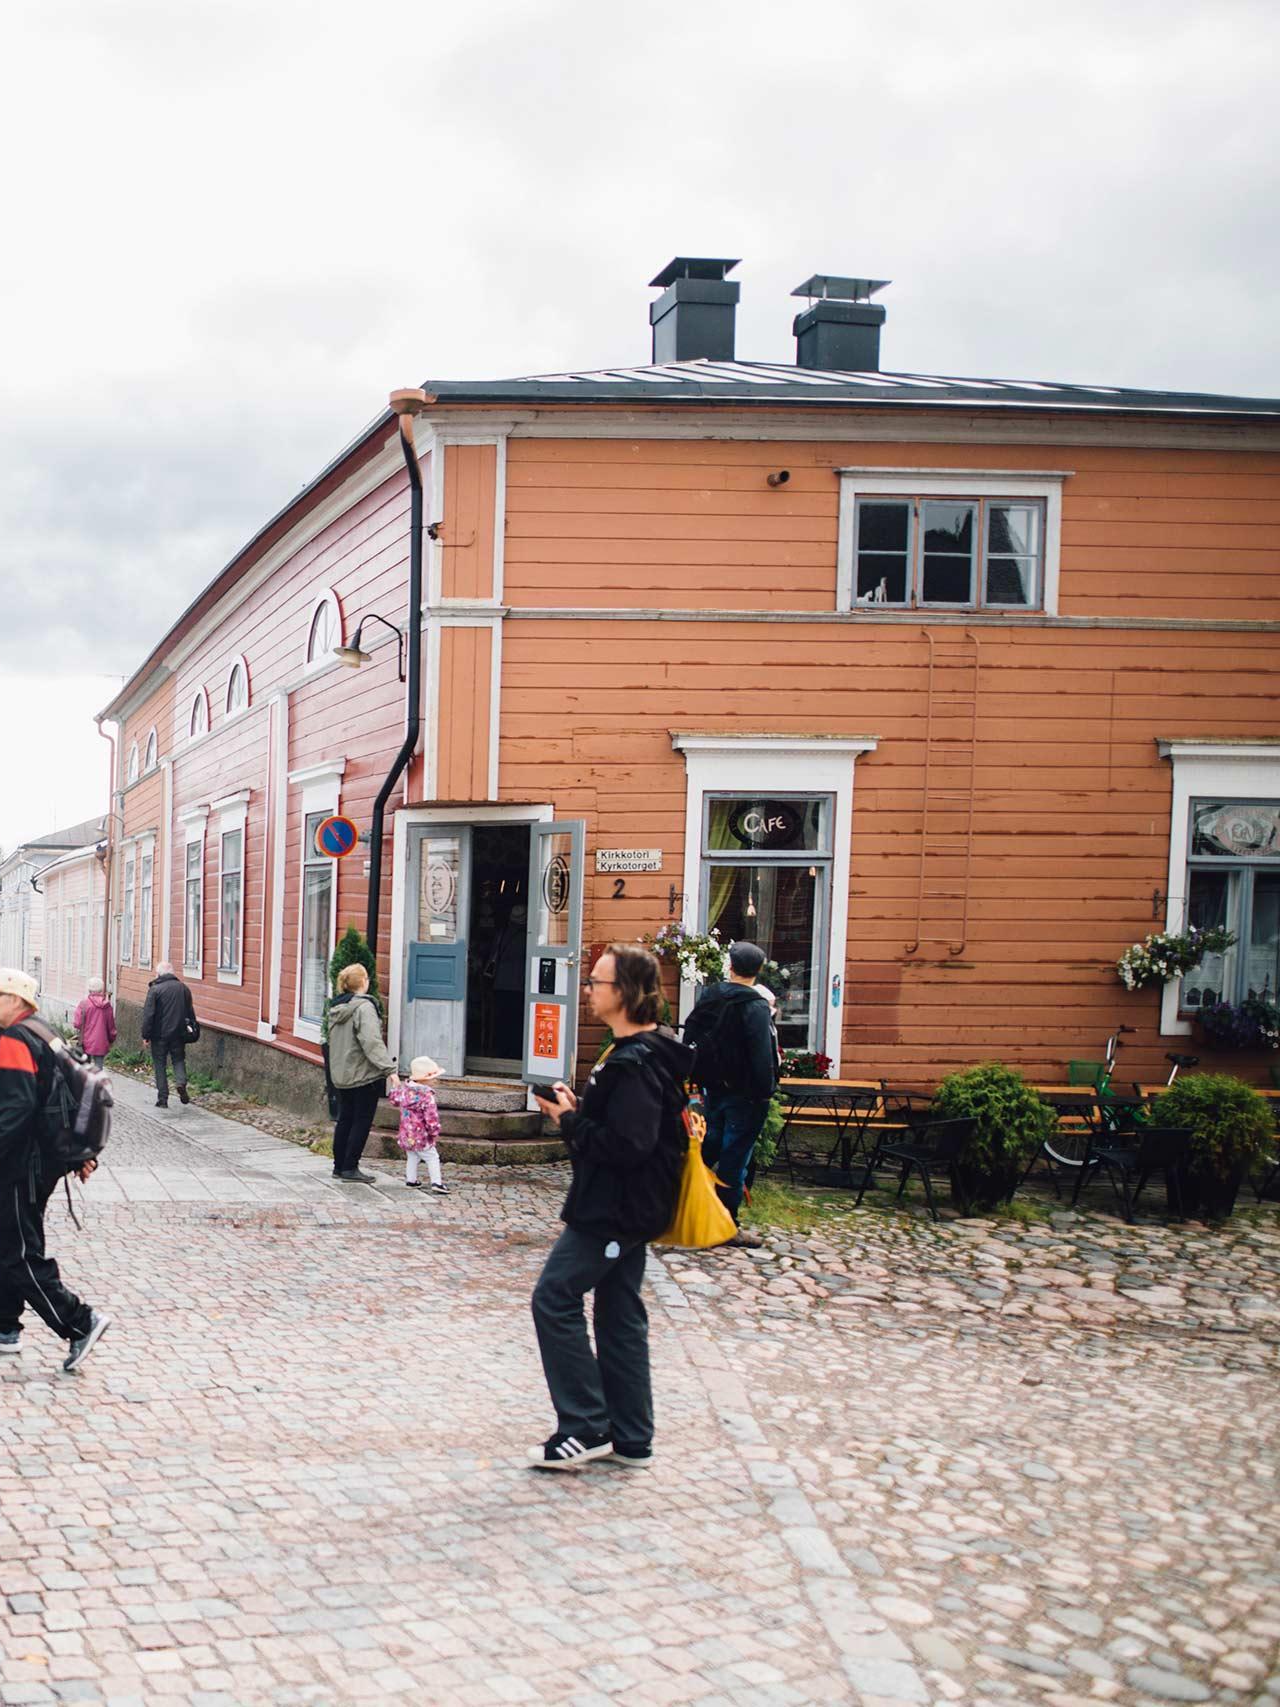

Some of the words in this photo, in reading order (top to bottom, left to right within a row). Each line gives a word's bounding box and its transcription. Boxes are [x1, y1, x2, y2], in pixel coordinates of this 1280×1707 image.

[744, 813, 786, 833] CAFE
[601, 851, 649, 859] Kirkkotori
[601, 862, 657, 872] Kyrkotorget
[613, 879, 625, 899] 2
